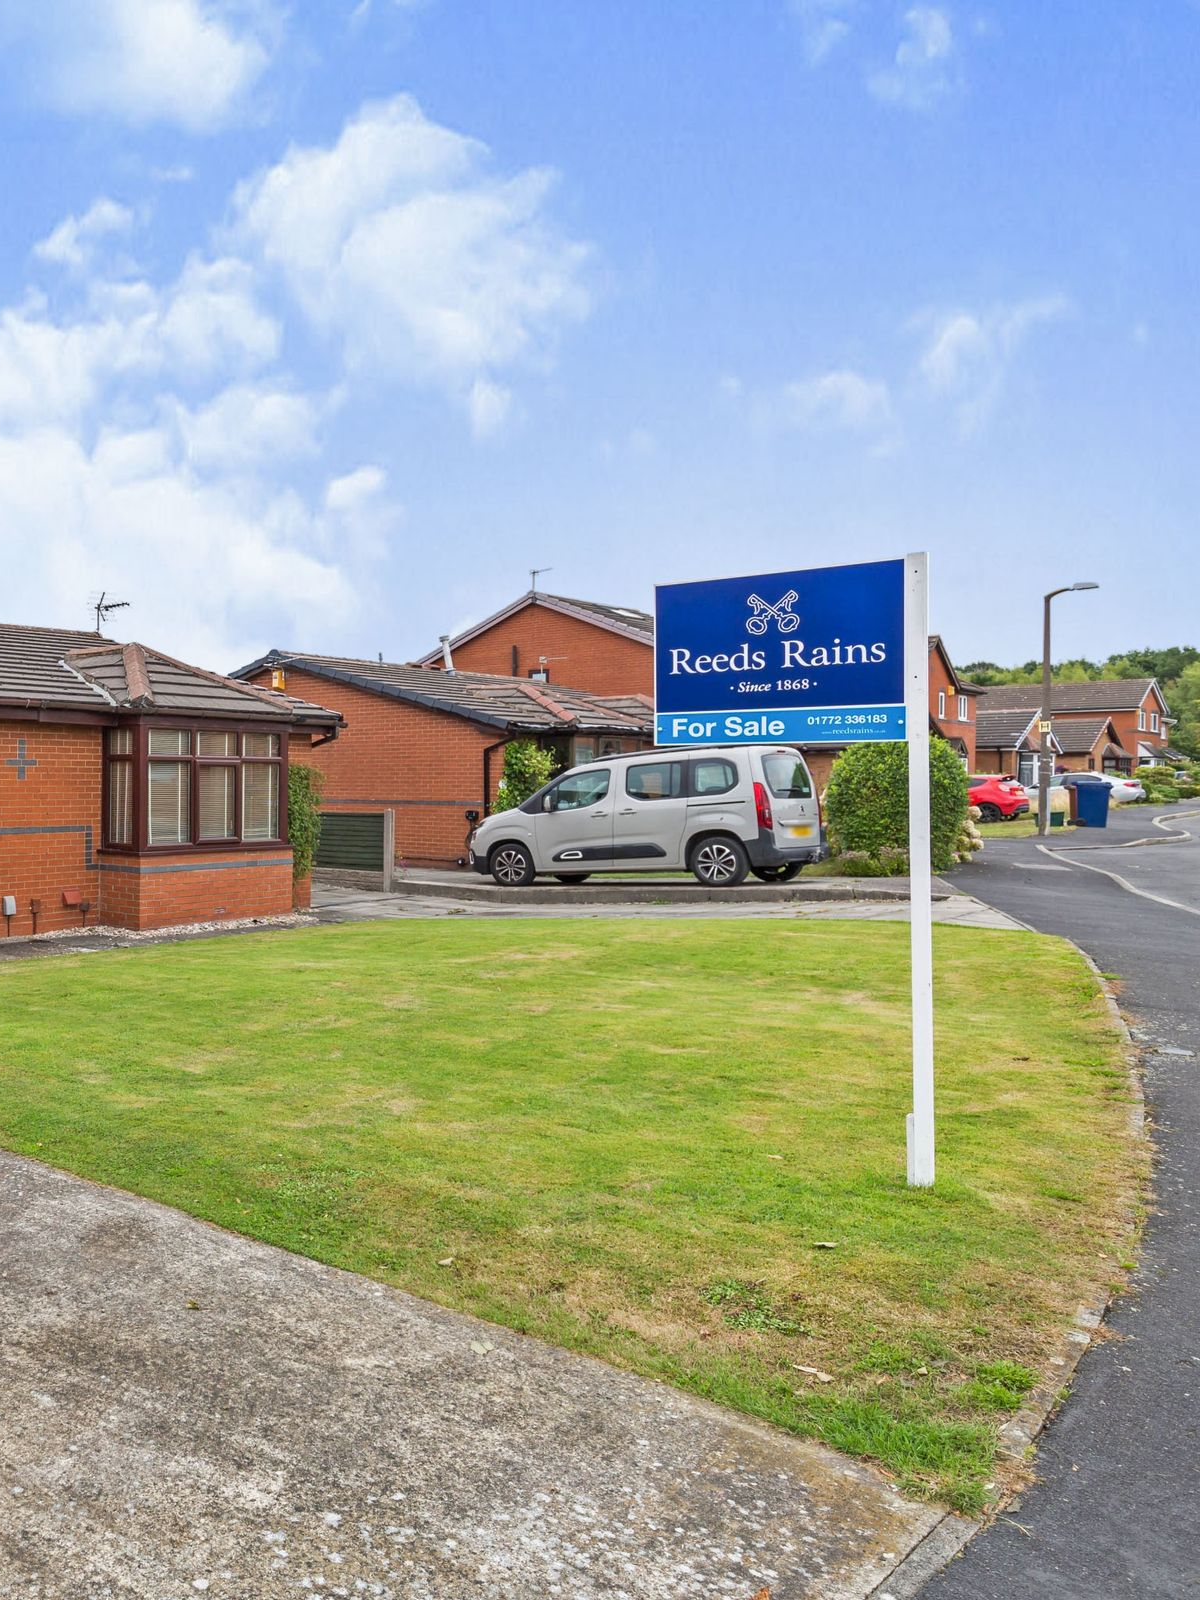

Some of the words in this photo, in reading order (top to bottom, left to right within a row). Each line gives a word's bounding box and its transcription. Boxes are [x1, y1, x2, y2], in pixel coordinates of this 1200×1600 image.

[669, 643, 766, 675] Reeds
[780, 638, 887, 668] Rains
[737, 681, 772, 693] Since
[776, 678, 810, 691] 1868
[672, 718, 717, 737] For
[724, 716, 785, 736] Sale
[807, 716, 842, 725] 01772
[845, 714, 888, 724] 336183
